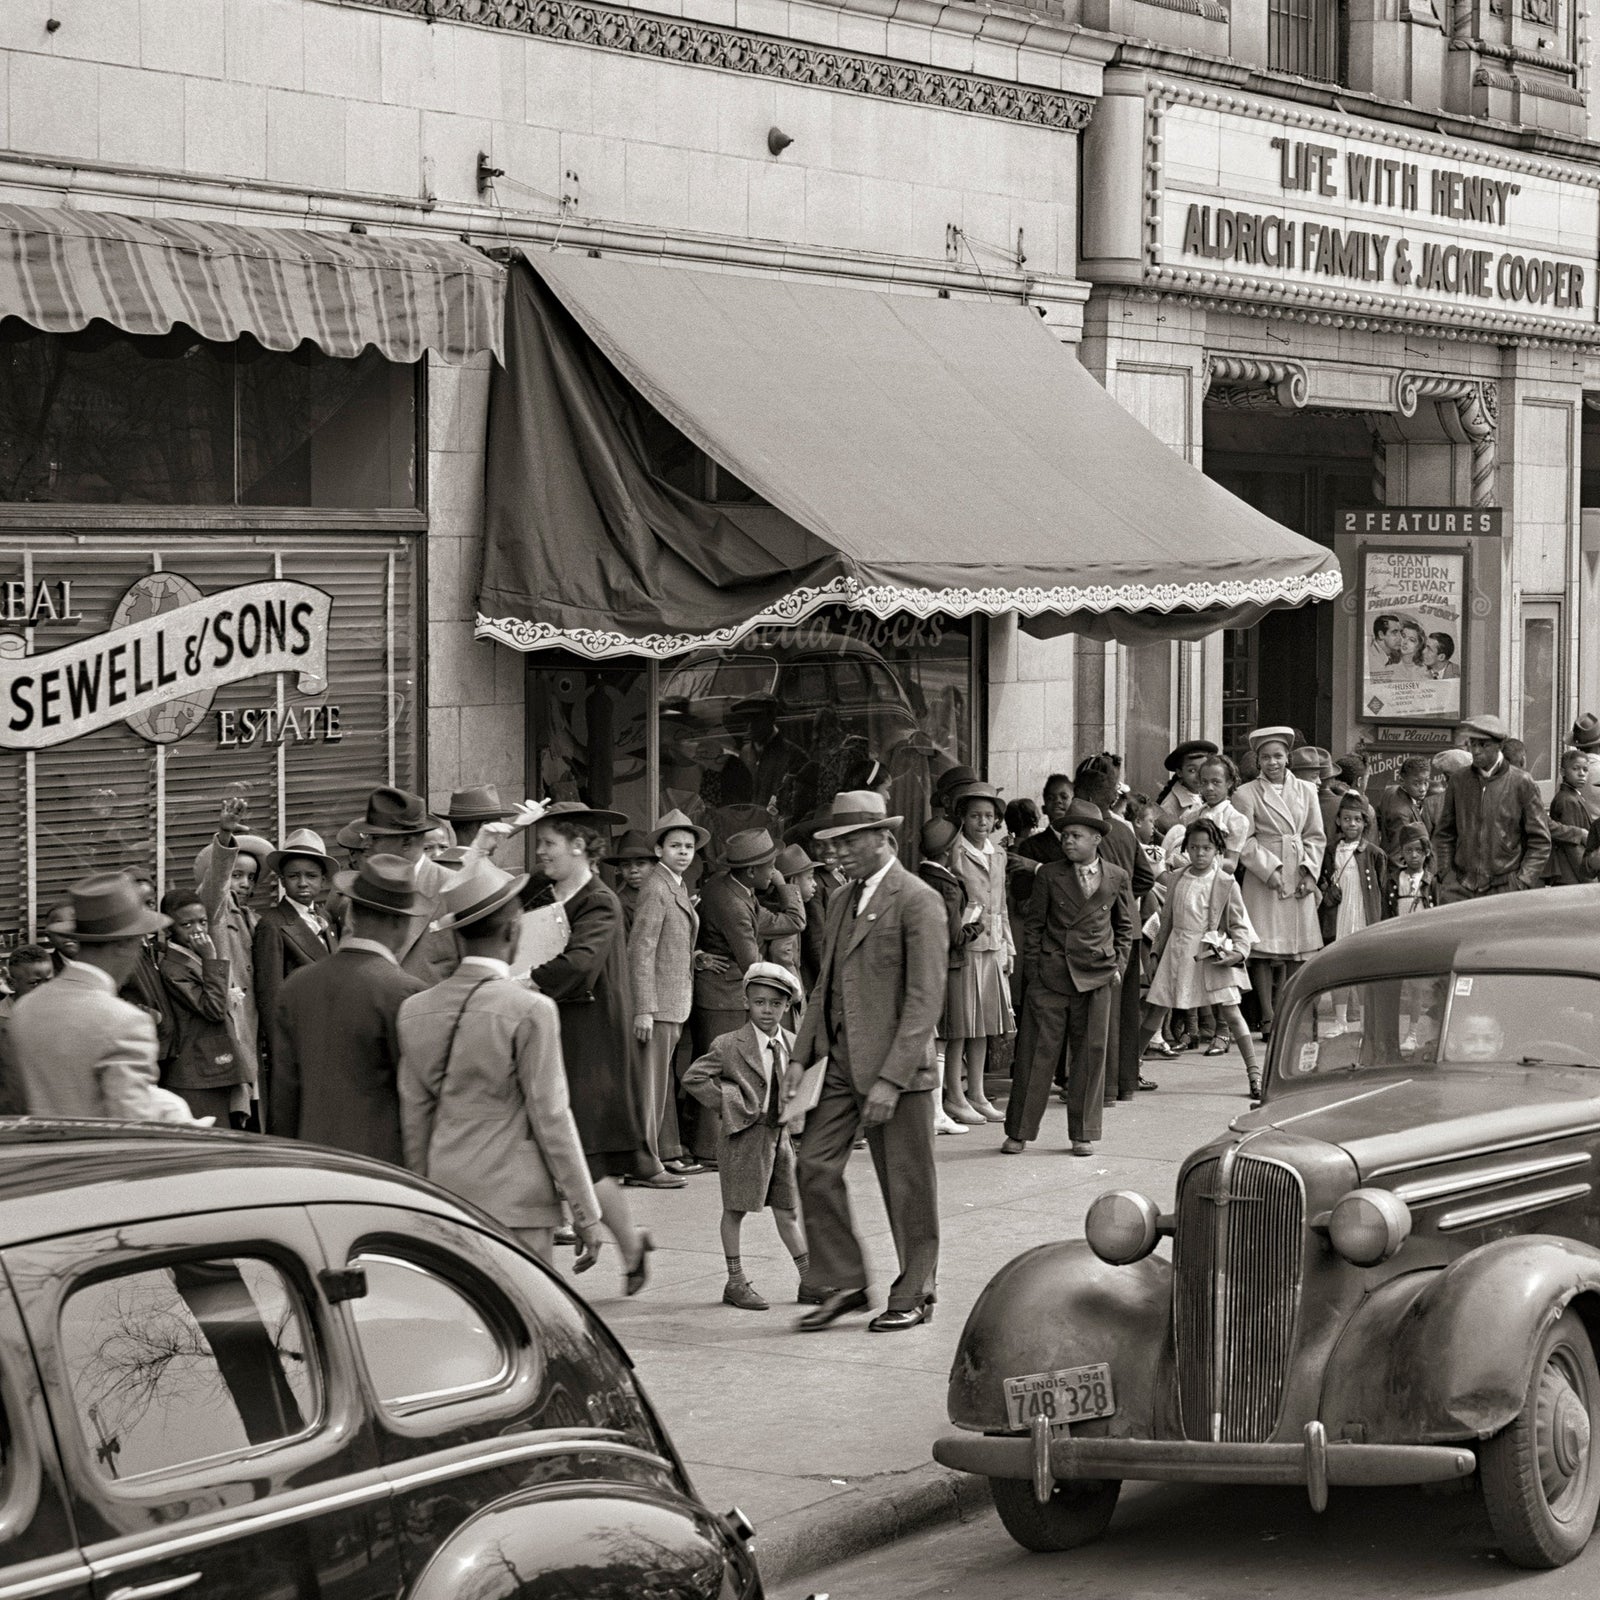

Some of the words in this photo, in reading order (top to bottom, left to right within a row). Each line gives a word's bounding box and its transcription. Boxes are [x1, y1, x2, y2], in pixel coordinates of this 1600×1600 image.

[1348, 151, 1418, 211] WITH
[1184, 203, 1296, 268] ALDRICH
[1303, 222, 1389, 281] FAMILY
[1394, 238, 1413, 285] &
[1416, 242, 1492, 297] JACKIE
[1499, 252, 1584, 308] COOPER
[1345, 513, 1356, 531] 2
[1366, 513, 1491, 532] FEATURES
[1387, 554, 1431, 567] GRANT
[1393, 567, 1449, 579] HEPBURN
[1399, 580, 1456, 593] STEWART
[0, 580, 82, 620] EAL
[1368, 594, 1449, 610] PHILADELPHIA
[1418, 605, 1460, 622] STORY
[9, 630, 177, 731] SEWELL
[185, 618, 209, 677] &
[213, 600, 314, 668] SONS
[1394, 682, 1420, 690] HUSSEY
[218, 706, 343, 745] ESTATE
[1381, 729, 1400, 740] Now
[1368, 753, 1383, 762] THE
[1010, 1378, 1067, 1394] ILLINOIS
[1078, 1371, 1105, 1382] 1941
[1012, 1391, 1056, 1423] 748
[1065, 1382, 1107, 1416] 328
